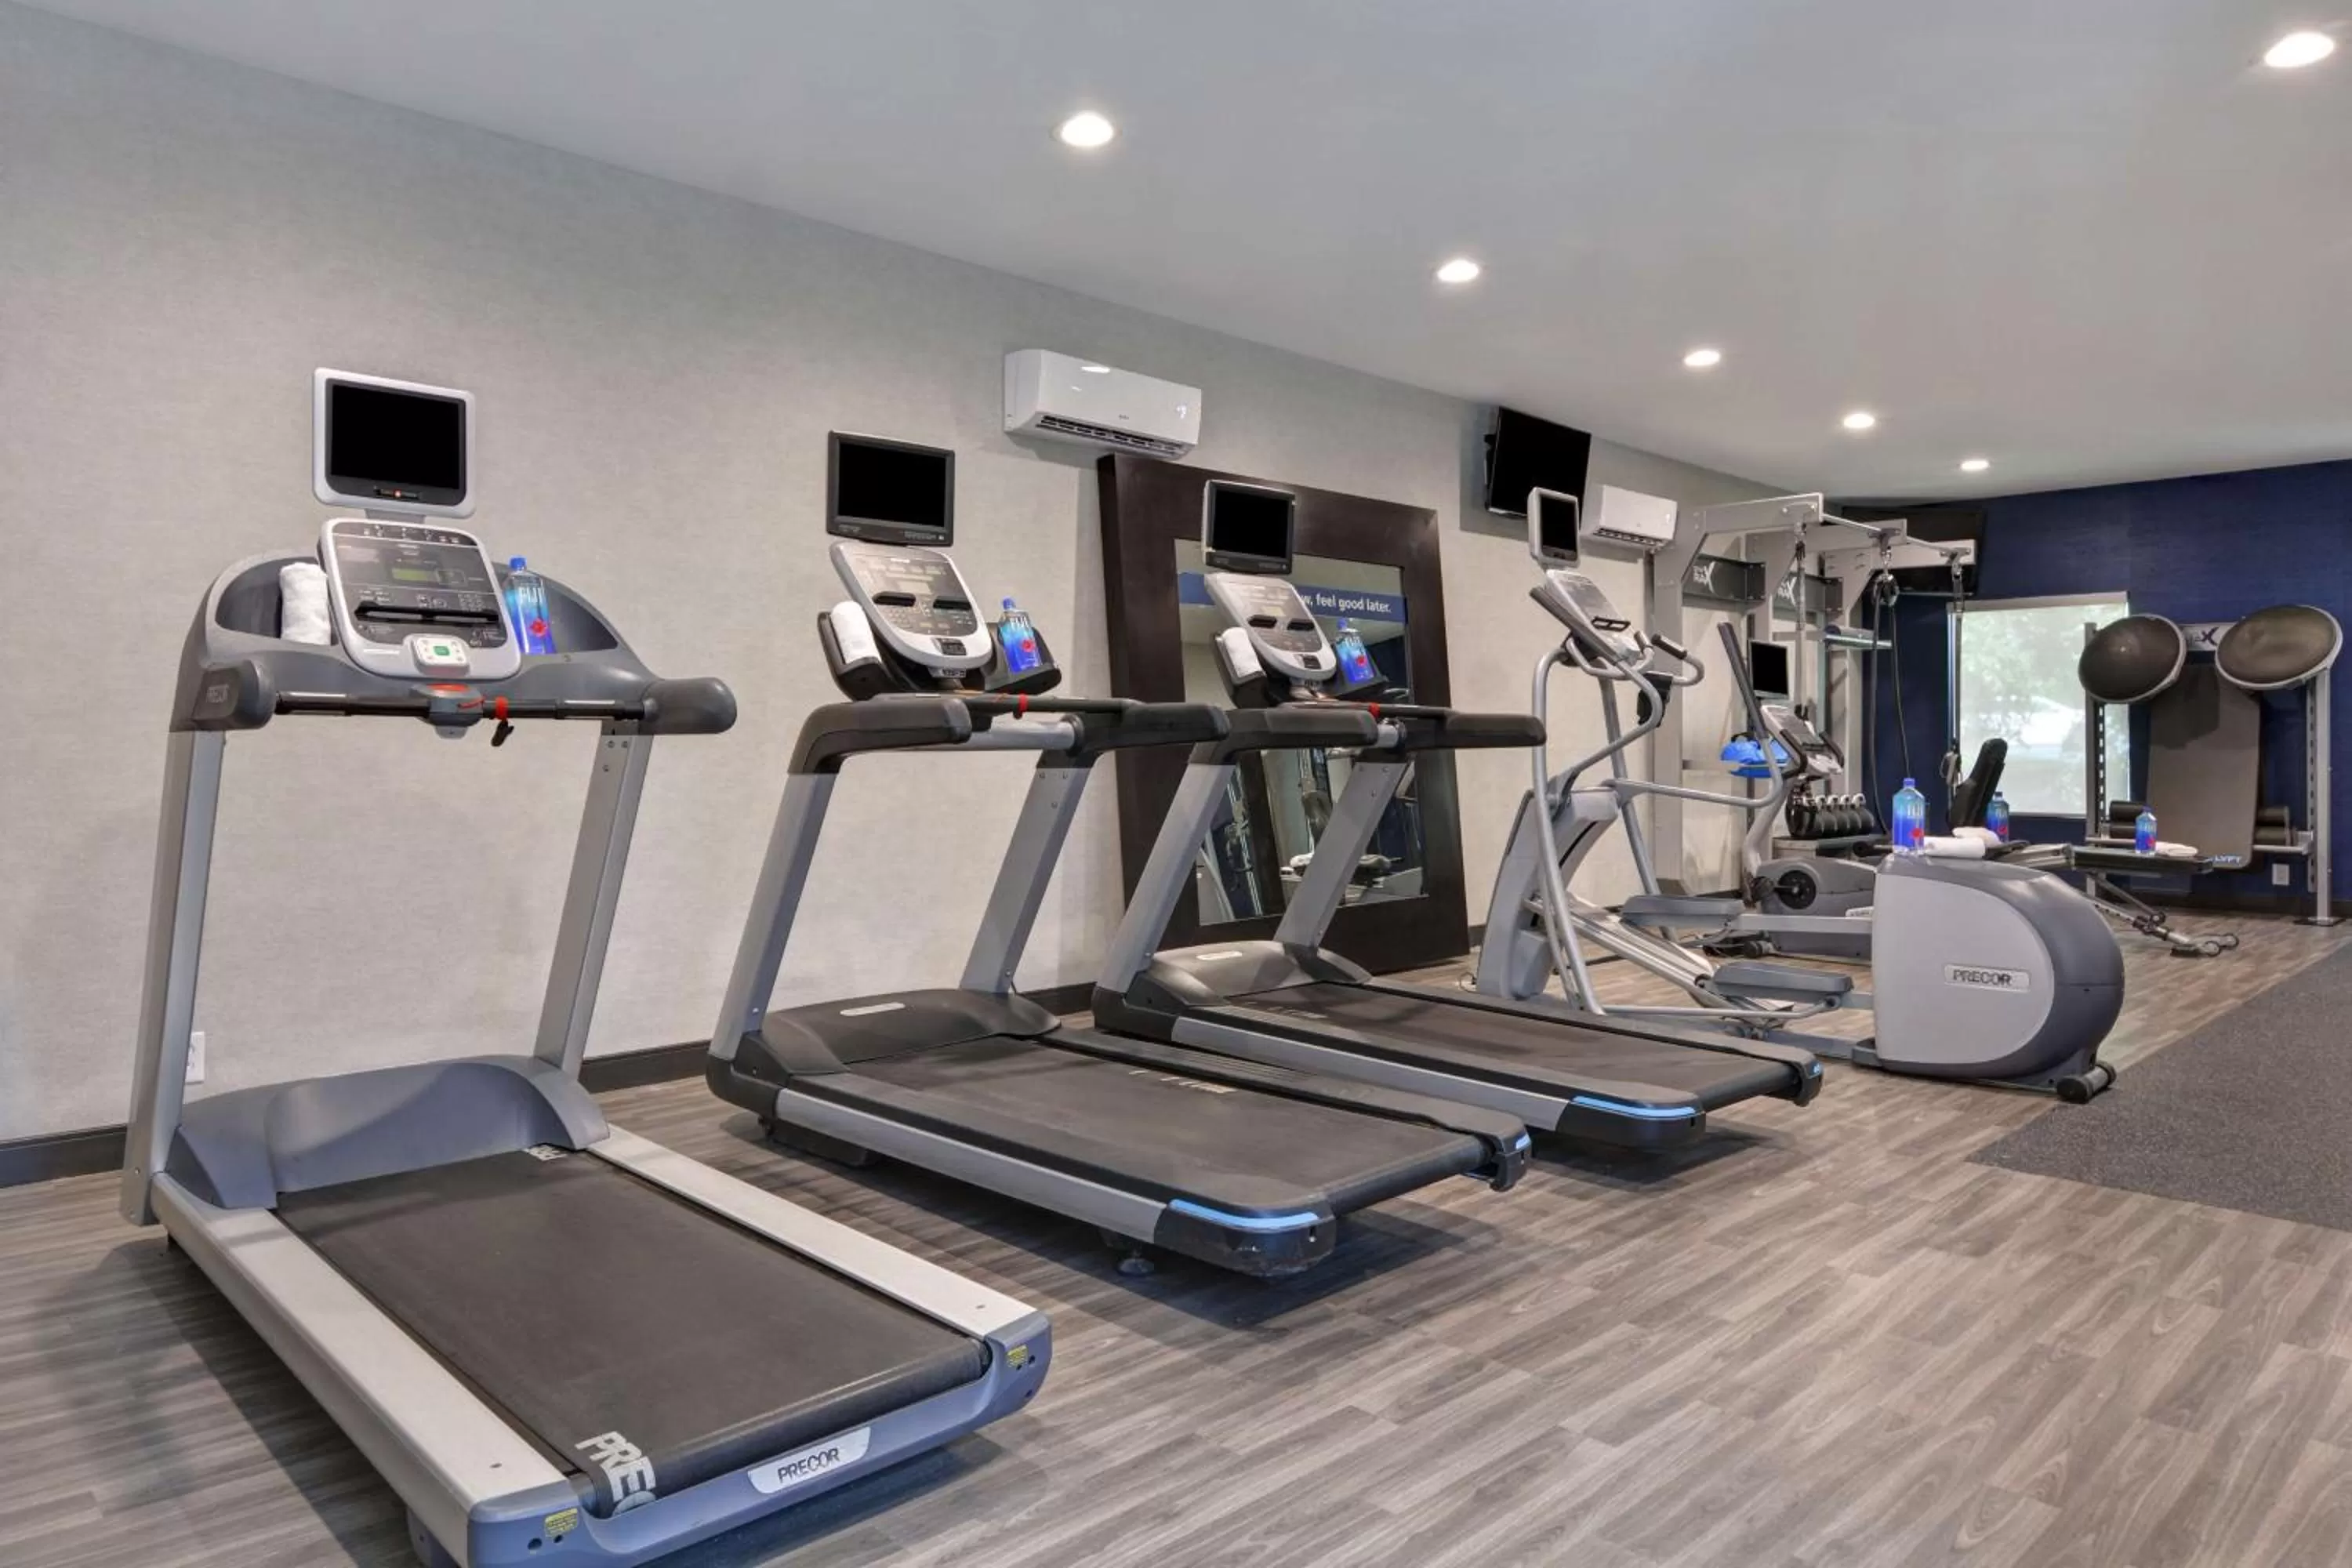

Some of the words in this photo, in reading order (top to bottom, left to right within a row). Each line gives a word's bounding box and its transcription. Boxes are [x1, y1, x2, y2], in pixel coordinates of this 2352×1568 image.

[1316, 593, 1337, 608] feel
[1338, 596, 1365, 612] good
[1367, 597, 1392, 613] later.
[1952, 969, 2012, 986] PRECOR
[777, 1447, 840, 1484] PRECOR
